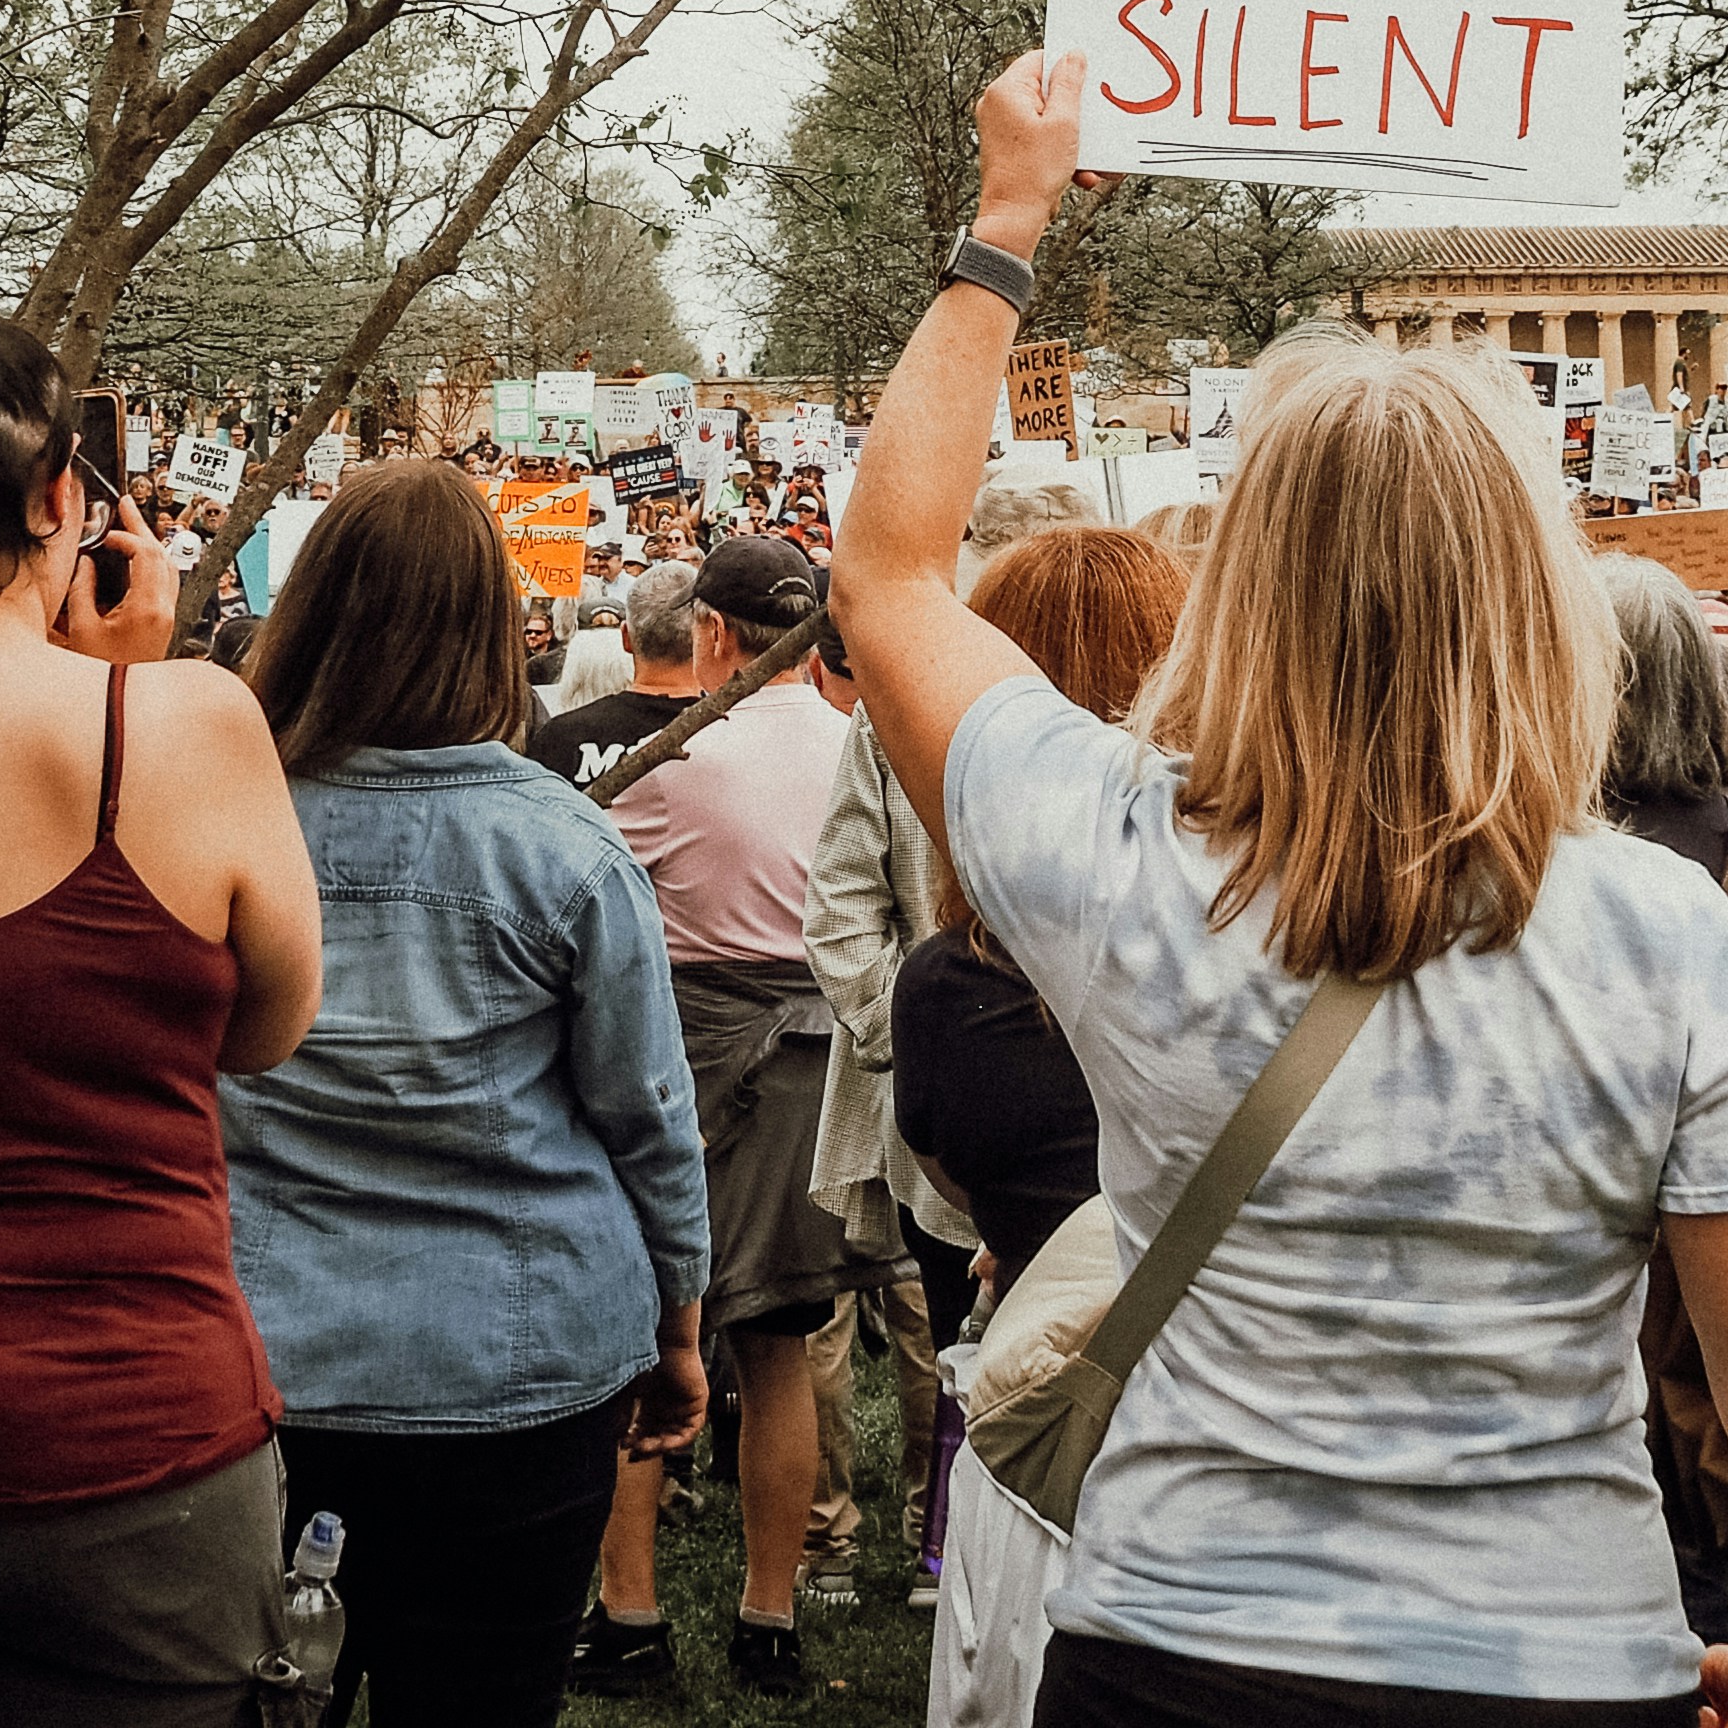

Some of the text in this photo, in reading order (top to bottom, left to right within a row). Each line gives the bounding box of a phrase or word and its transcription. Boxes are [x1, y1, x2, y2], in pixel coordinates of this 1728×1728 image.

[1009, 345, 1066, 375] THERE
[1567, 363, 1593, 376] OCK
[1020, 373, 1063, 402] ARE
[1204, 378, 1220, 386] NO
[655, 386, 692, 407] THANK
[1015, 404, 1067, 437] MORE
[193, 442, 229, 458] HANDS
[190, 452, 227, 472] OFF!
[175, 472, 229, 492] DEMOCRACY
[197, 467, 215, 478] OUR
[488, 493, 576, 514] CUTS TO
